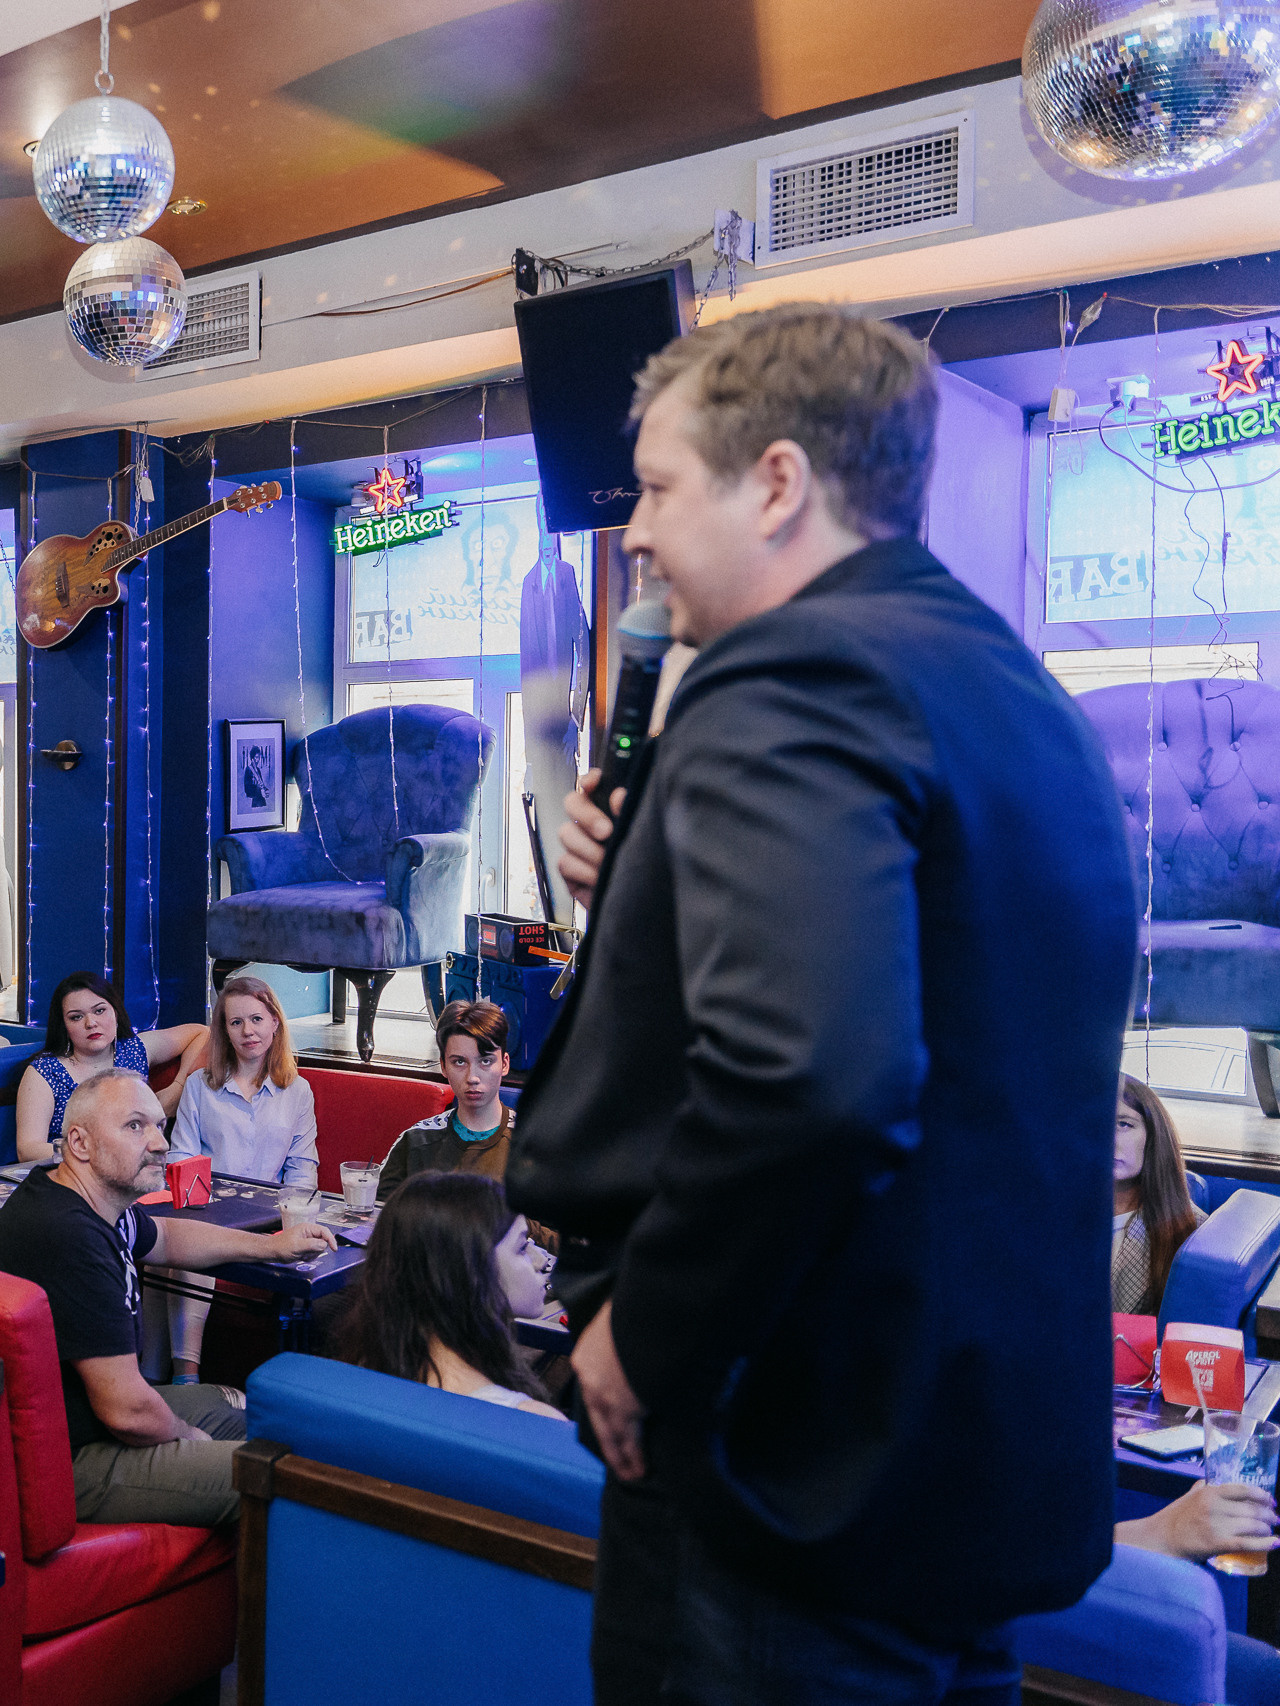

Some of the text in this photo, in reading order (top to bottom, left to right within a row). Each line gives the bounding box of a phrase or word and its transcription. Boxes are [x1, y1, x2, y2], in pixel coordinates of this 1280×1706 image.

[334, 500, 453, 554] Heineken
[518, 925, 545, 936] SHOT
[1185, 1350, 1220, 1361] APEROL
